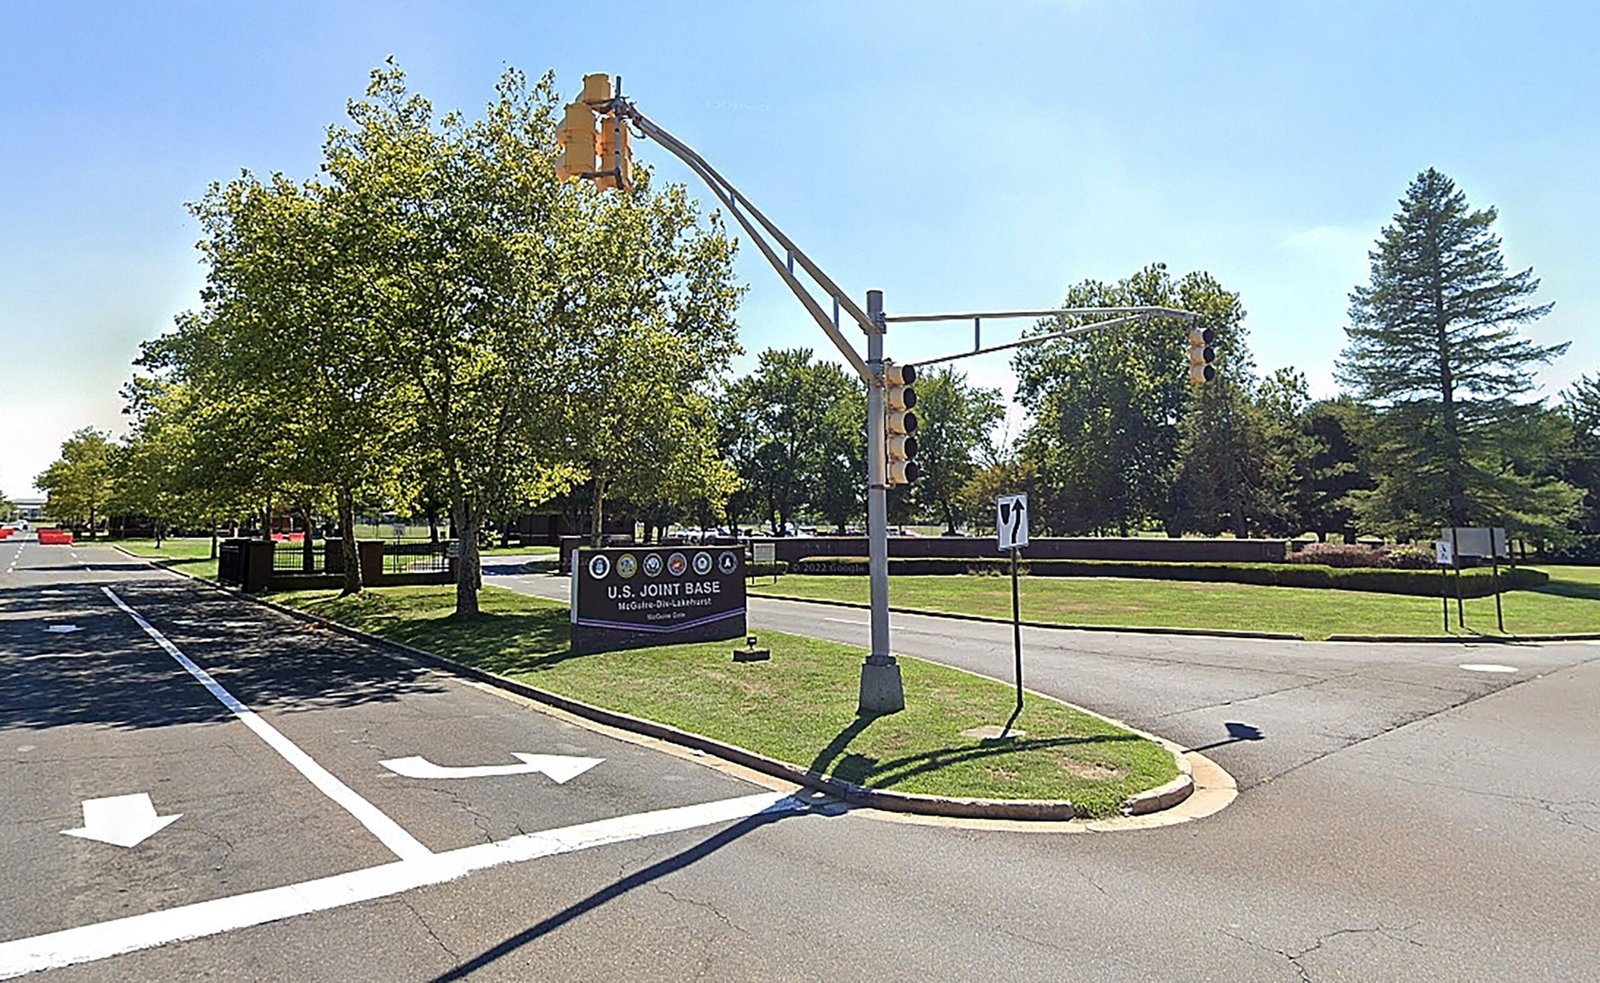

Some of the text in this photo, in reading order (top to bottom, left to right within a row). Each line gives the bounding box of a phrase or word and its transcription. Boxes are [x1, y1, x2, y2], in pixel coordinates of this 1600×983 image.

[608, 581, 720, 599] U.S. JOINT BASE
